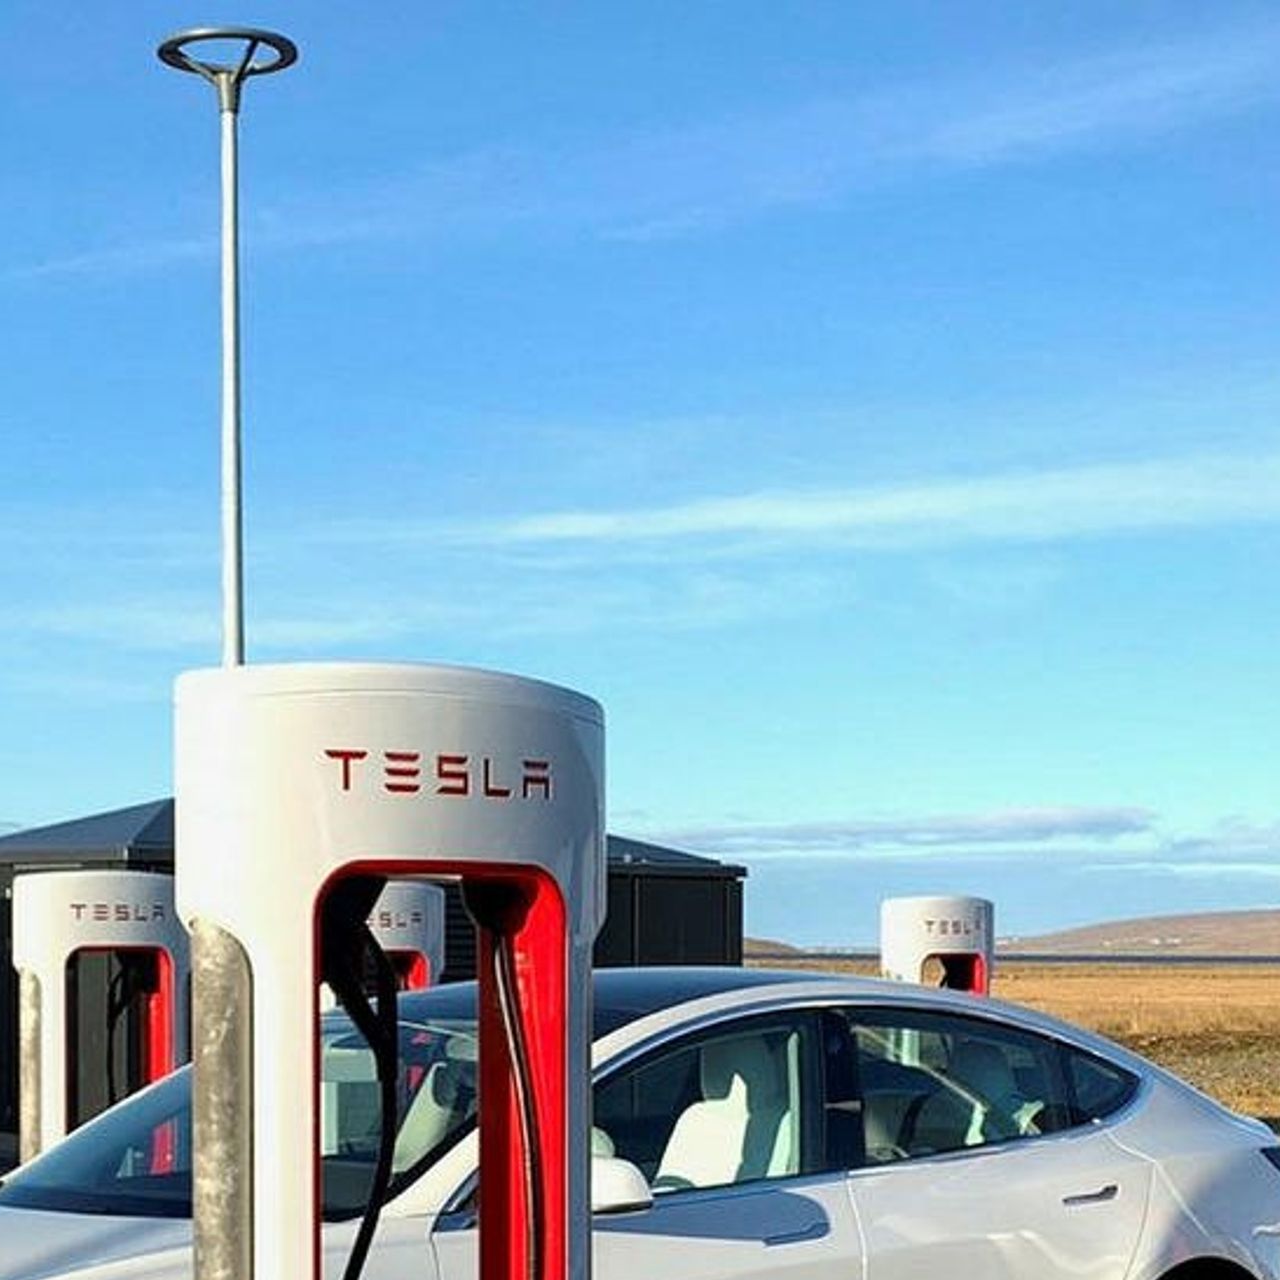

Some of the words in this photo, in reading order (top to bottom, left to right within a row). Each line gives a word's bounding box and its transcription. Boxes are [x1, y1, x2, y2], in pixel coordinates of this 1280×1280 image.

[324, 749, 550, 799] TESLA
[70, 903, 165, 921] TESLA
[371, 911, 422, 929] SLA
[924, 919, 983, 935] TESLA
